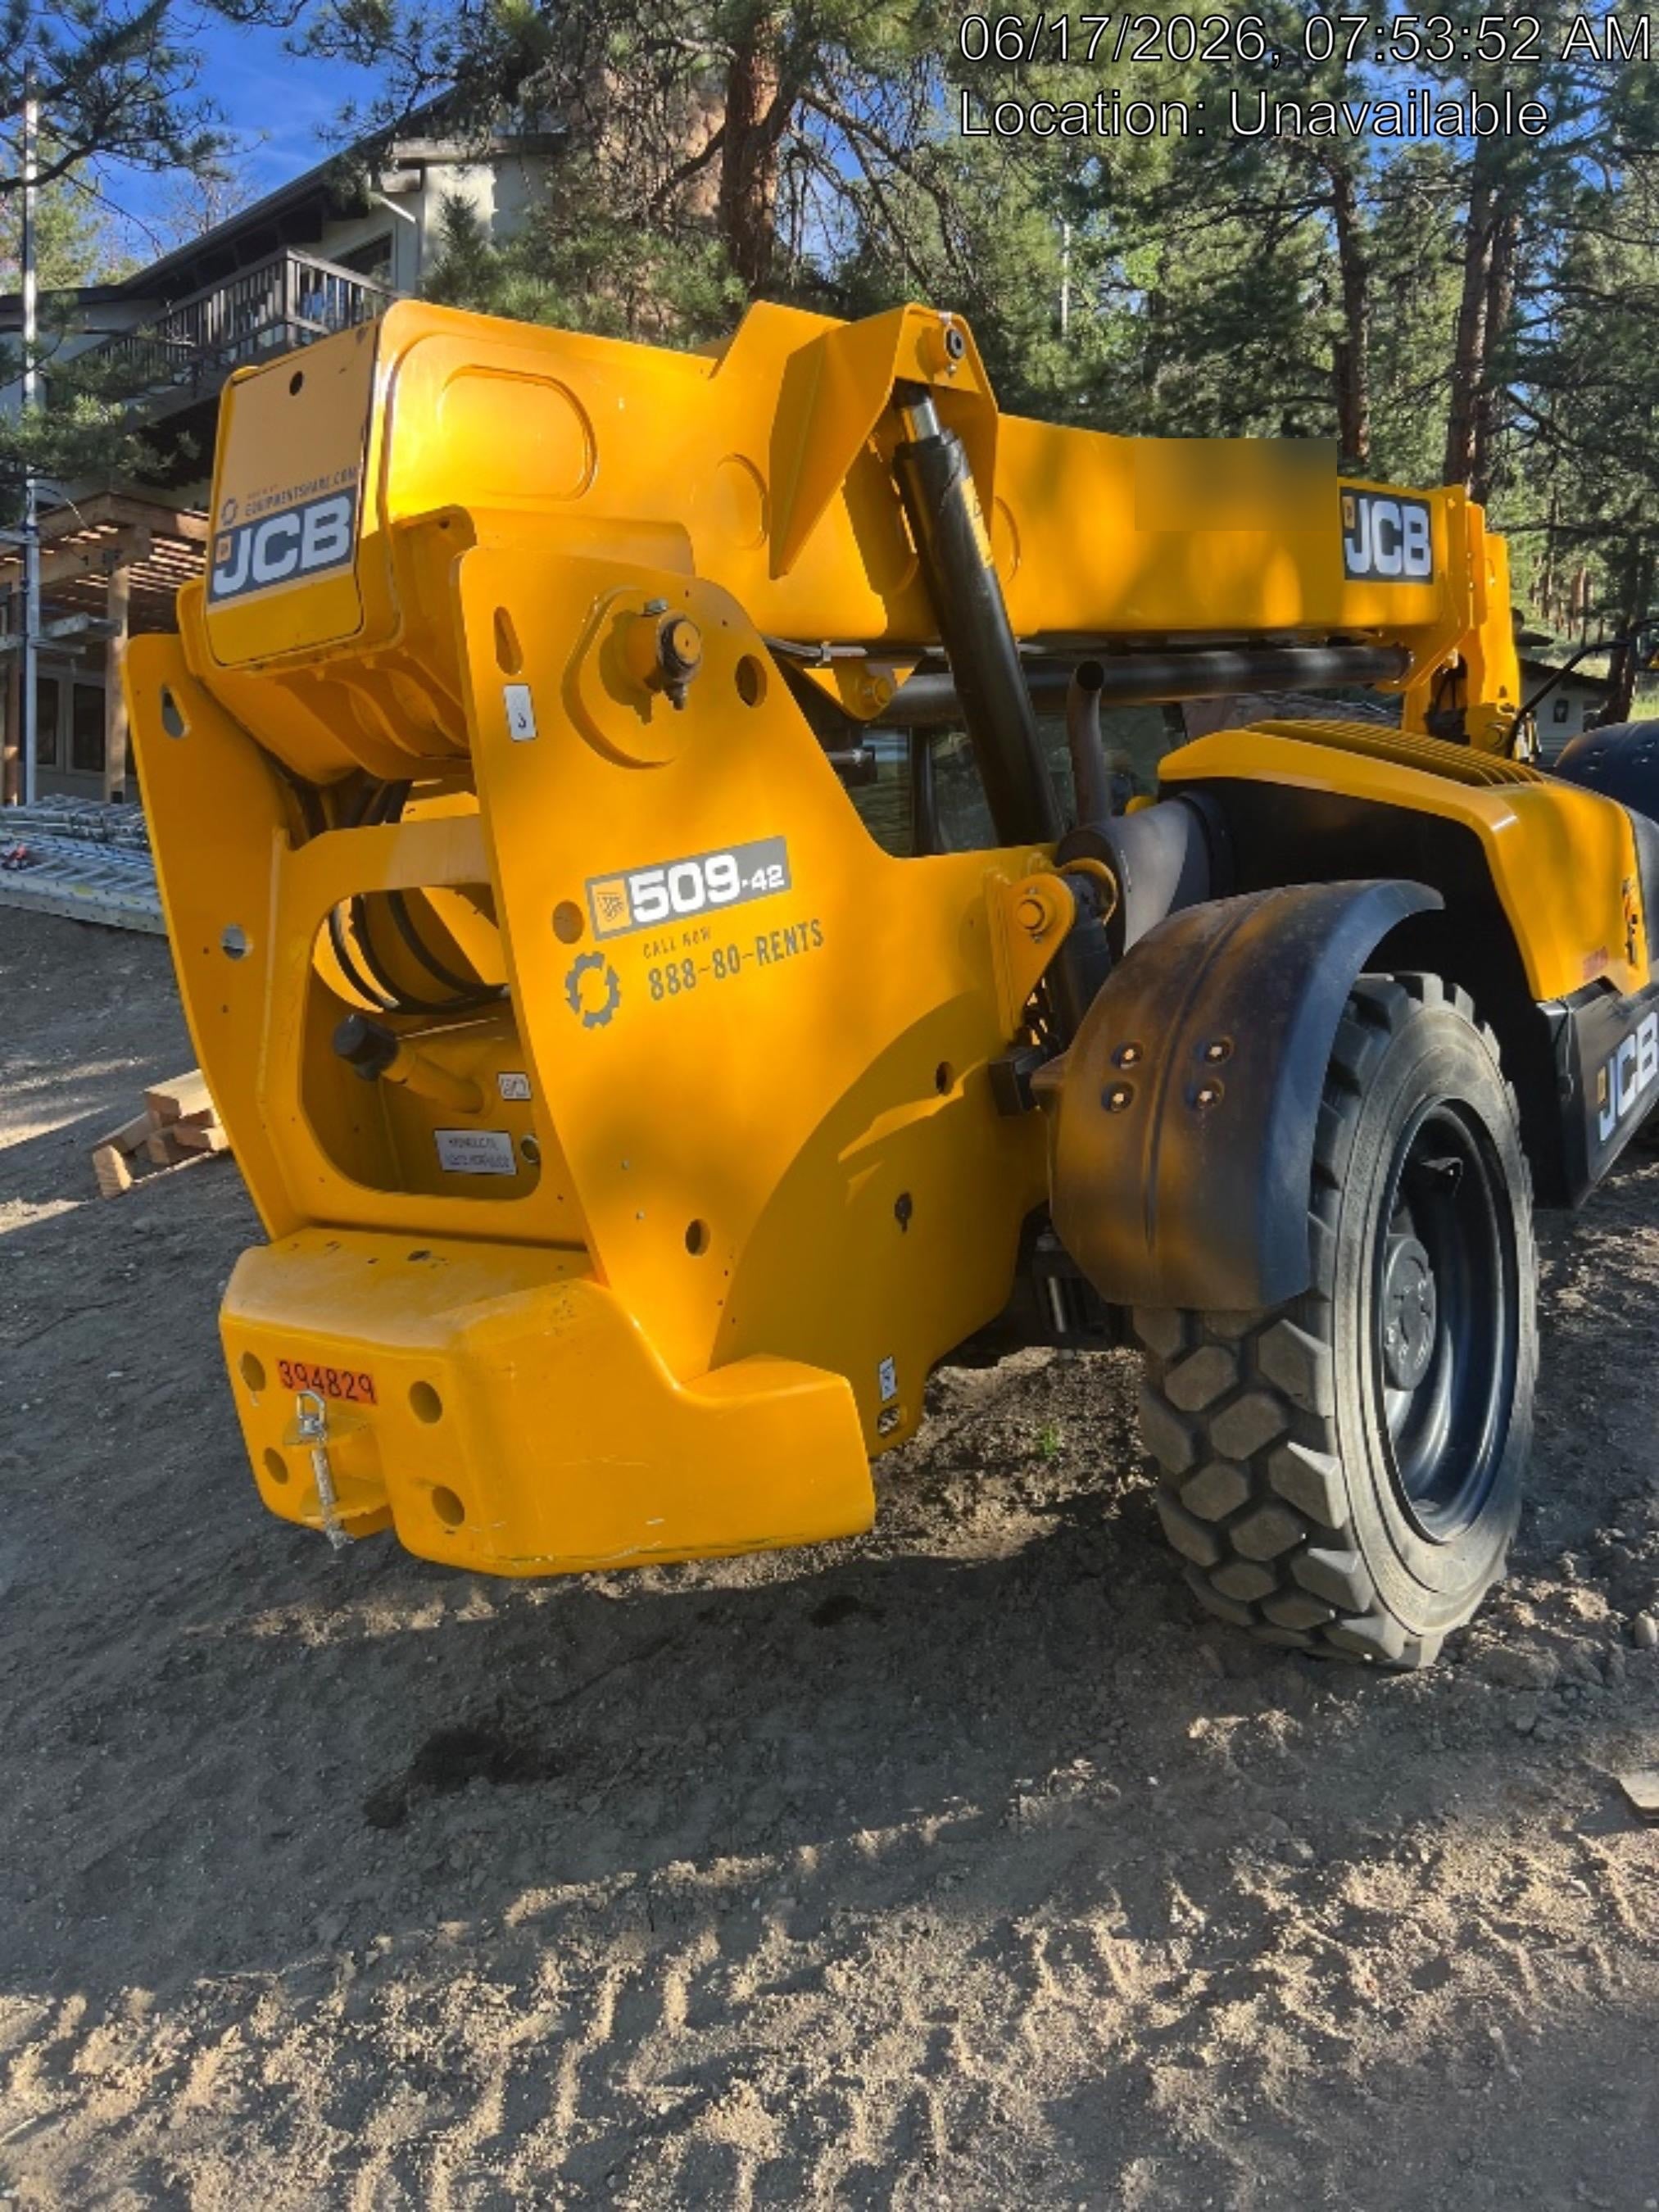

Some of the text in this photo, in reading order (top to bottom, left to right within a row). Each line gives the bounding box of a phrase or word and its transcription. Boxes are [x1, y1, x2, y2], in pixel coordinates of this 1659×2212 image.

[213, 496, 351, 595] JCB
[1344, 497, 1431, 576] JCB
[643, 936, 677, 959] CALL
[648, 918, 824, 1001] 888-80-RENTS
[1599, 1011, 1658, 1142] JCB
[279, 1360, 377, 1404] 394829
